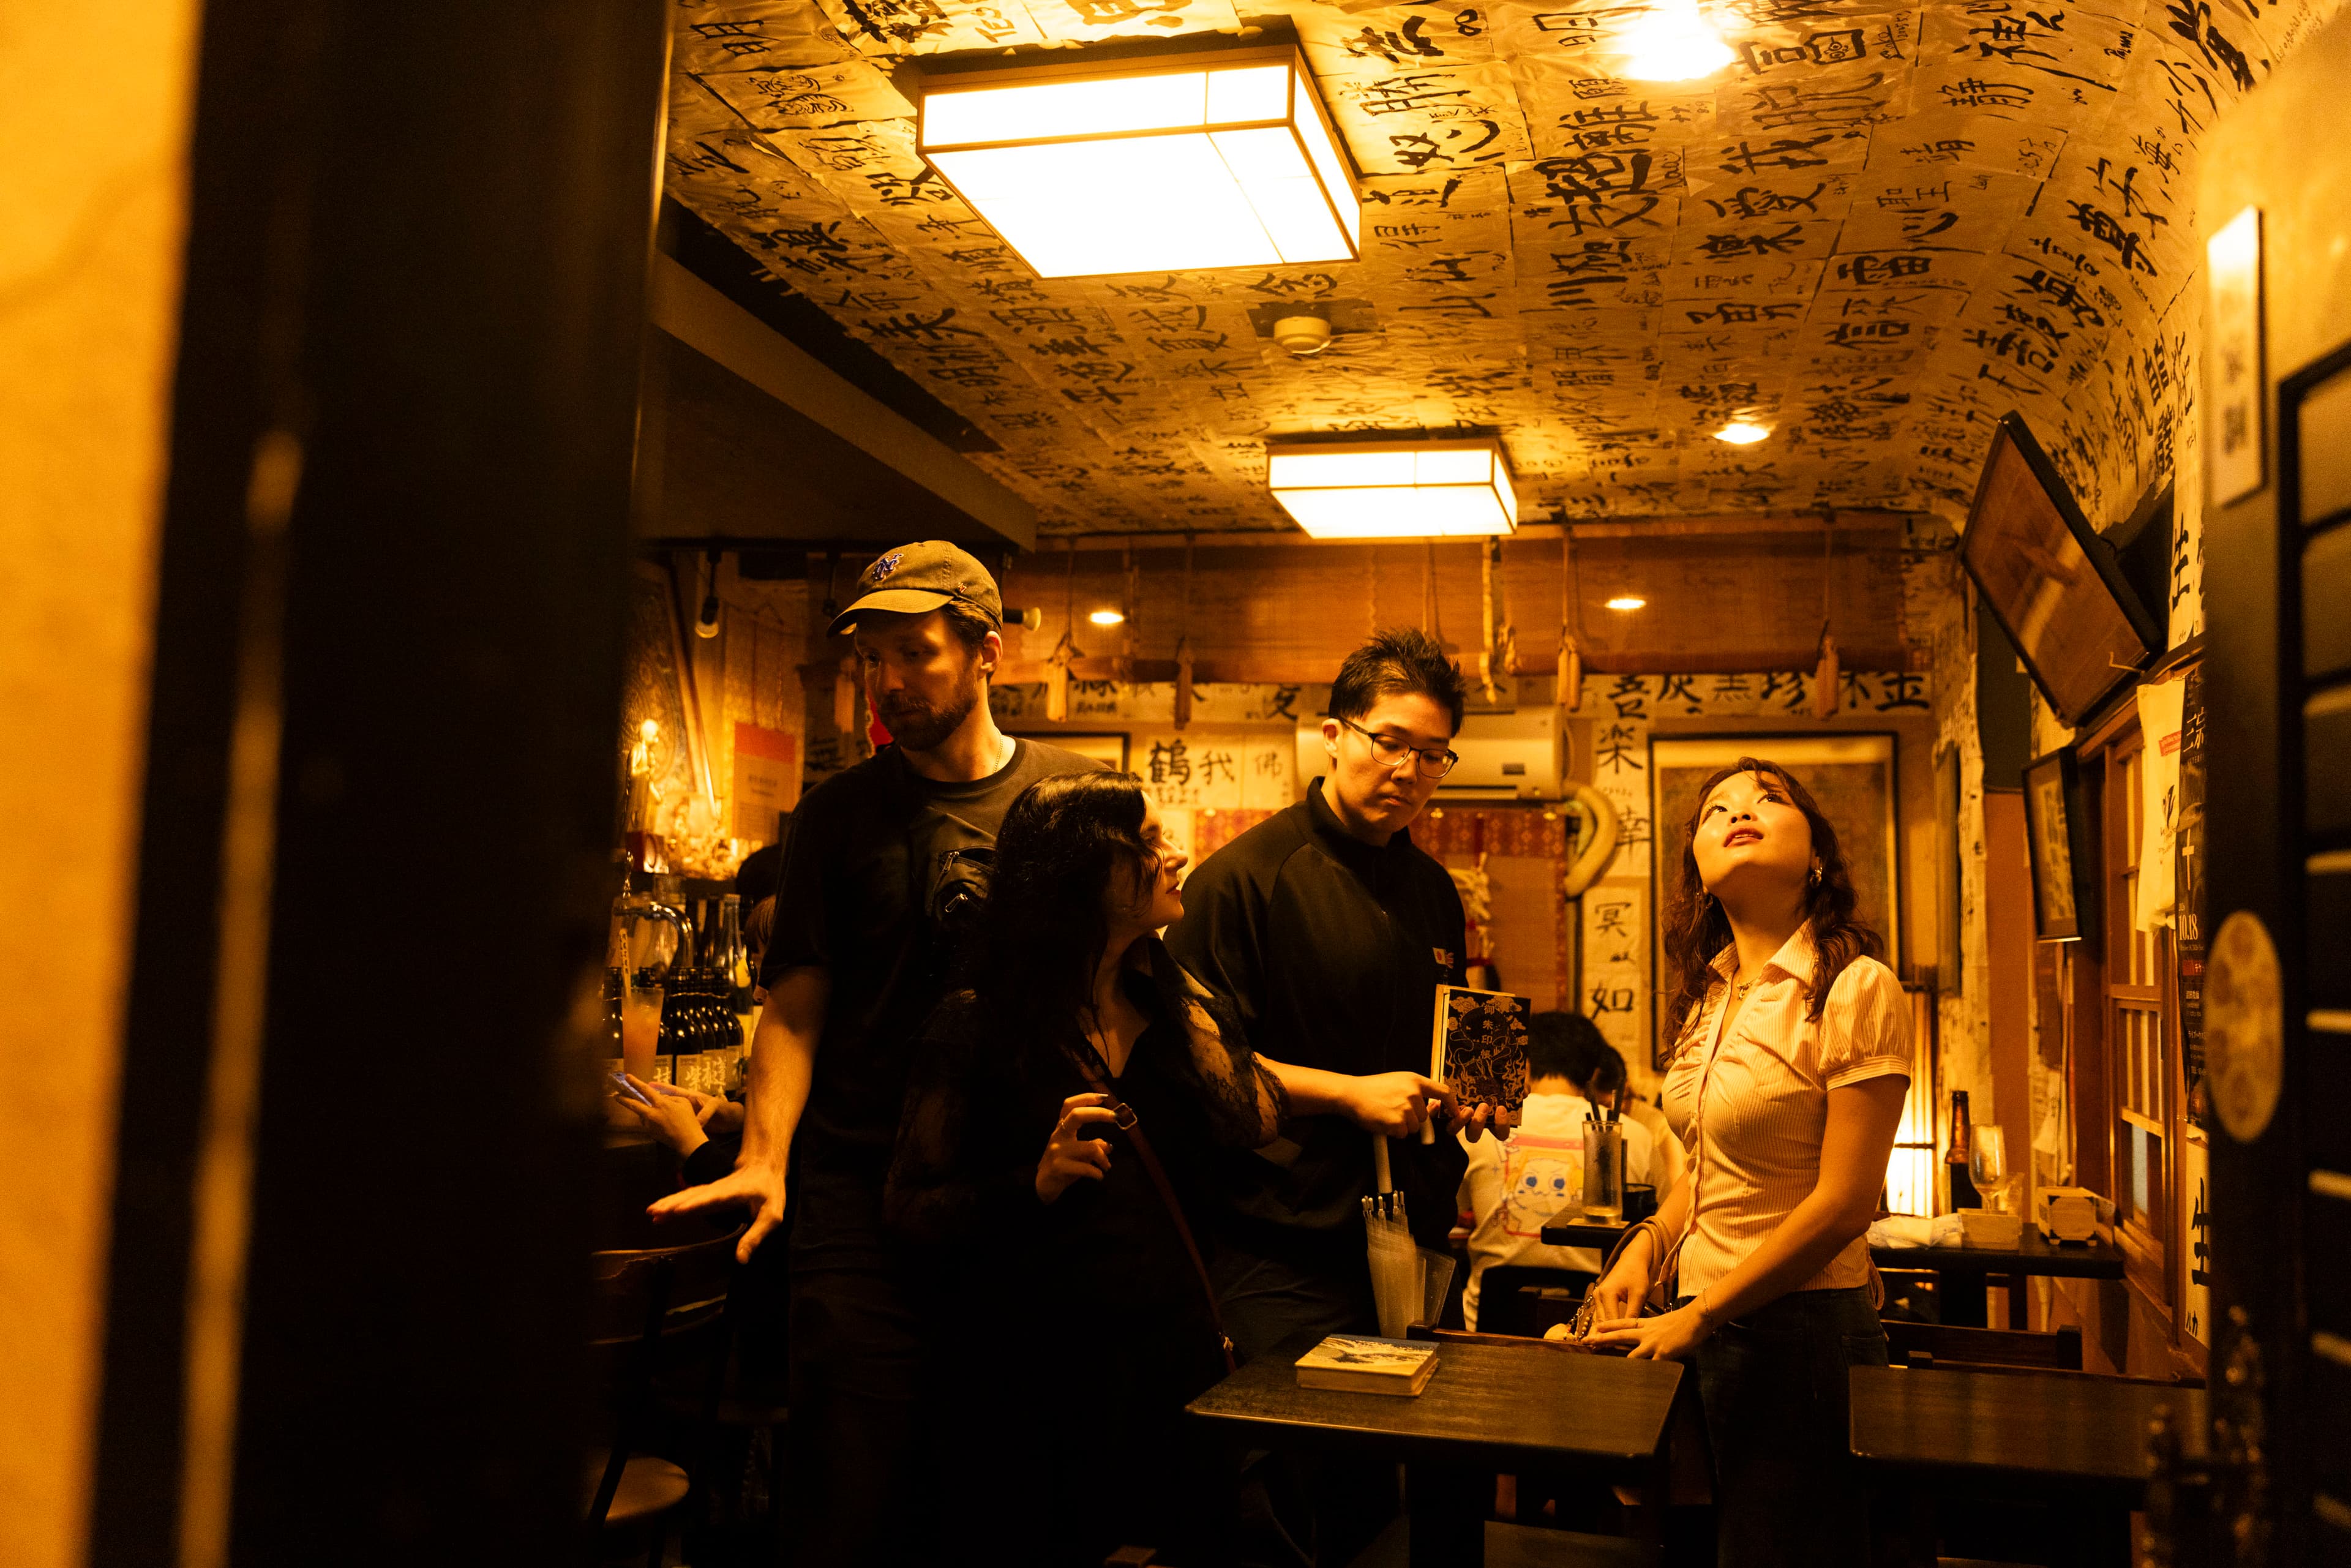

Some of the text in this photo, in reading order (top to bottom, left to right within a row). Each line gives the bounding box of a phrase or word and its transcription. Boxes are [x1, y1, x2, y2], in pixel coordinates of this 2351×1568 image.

[689, 17, 783, 61] 明
[1340, 72, 1472, 117] 勝
[1744, 72, 1885, 129] 脱
[1936, 77, 2034, 109] 静
[1389, 119, 1504, 167] 怒
[1559, 100, 1660, 150] 離
[1720, 133, 1835, 174] 我
[1901, 138, 1976, 165] 清
[2129, 134, 2181, 186] 海
[1534, 148, 1658, 198] 超
[1360, 177, 1463, 208] 道
[1704, 182, 1828, 220] 愛
[1877, 181, 1951, 209] 聖
[2085, 157, 2169, 239] 安
[1373, 222, 1444, 251] 得
[1901, 209, 1959, 243] 心
[2066, 198, 2158, 277] 尊
[1837, 254, 1933, 285] 雷
[2028, 236, 2100, 276] 喜
[823, 289, 920, 313] 命
[1246, 271, 1338, 298] 念
[1686, 302, 1805, 325] 勇
[1993, 304, 2069, 359] 渡
[1146, 332, 1233, 353] 夏
[1824, 320, 1911, 350] 信
[1961, 329, 2055, 373] 善
[923, 366, 1011, 389] 明
[1061, 386, 1139, 406] 平
[1149, 738, 1191, 786] 鶴
[1199, 749, 1235, 786] 我
[1597, 724, 1643, 774] 楽
[1595, 901, 1632, 938] 冥
[2178, 913, 2198, 941] 10.18
[1589, 981, 1634, 1019] 如
[1480, 1003, 1495, 1060] 御朱印帳
